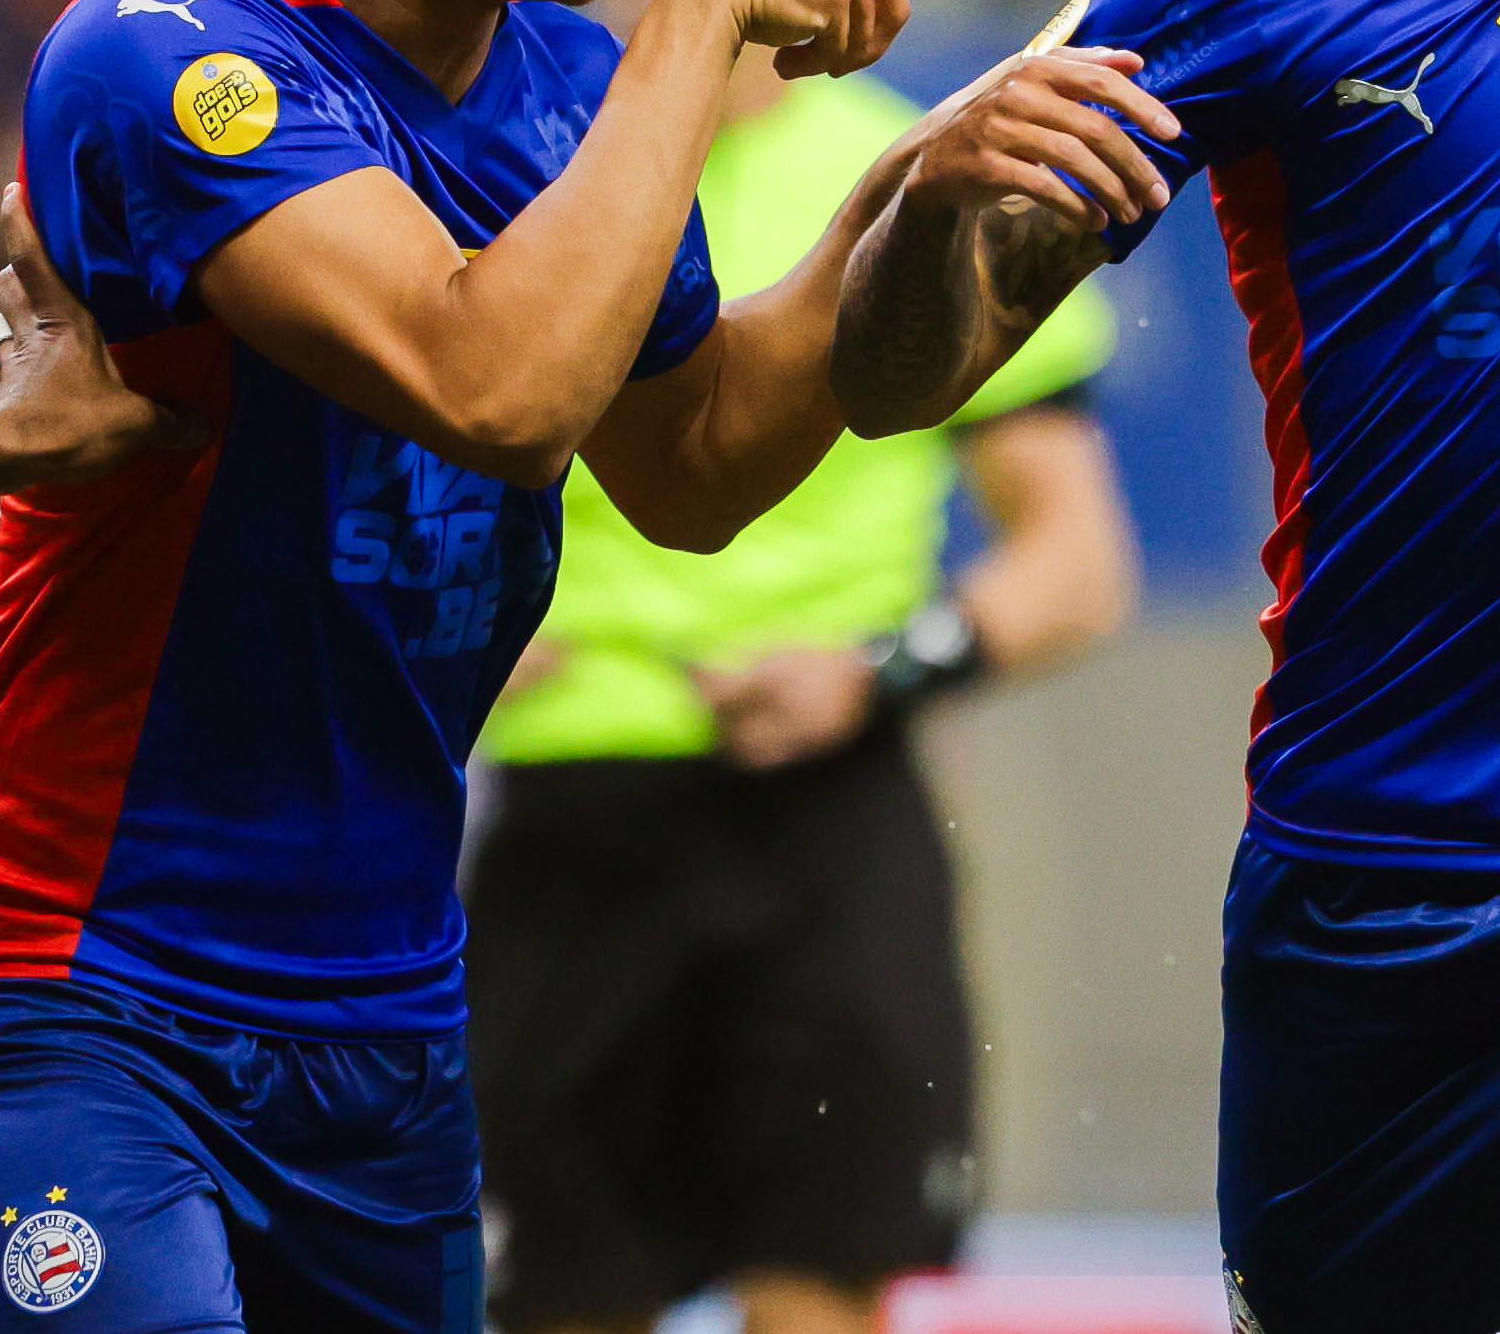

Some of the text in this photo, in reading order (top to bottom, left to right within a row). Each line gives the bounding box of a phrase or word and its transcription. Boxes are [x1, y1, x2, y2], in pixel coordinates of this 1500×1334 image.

[199, 79, 259, 142] gols
[331, 507, 501, 589] SOR
[401, 578, 501, 658] .BE
[7, 1215, 95, 1301] ESPORTE CLUBE BAHIA
[49, 1285, 77, 1305] 1931
